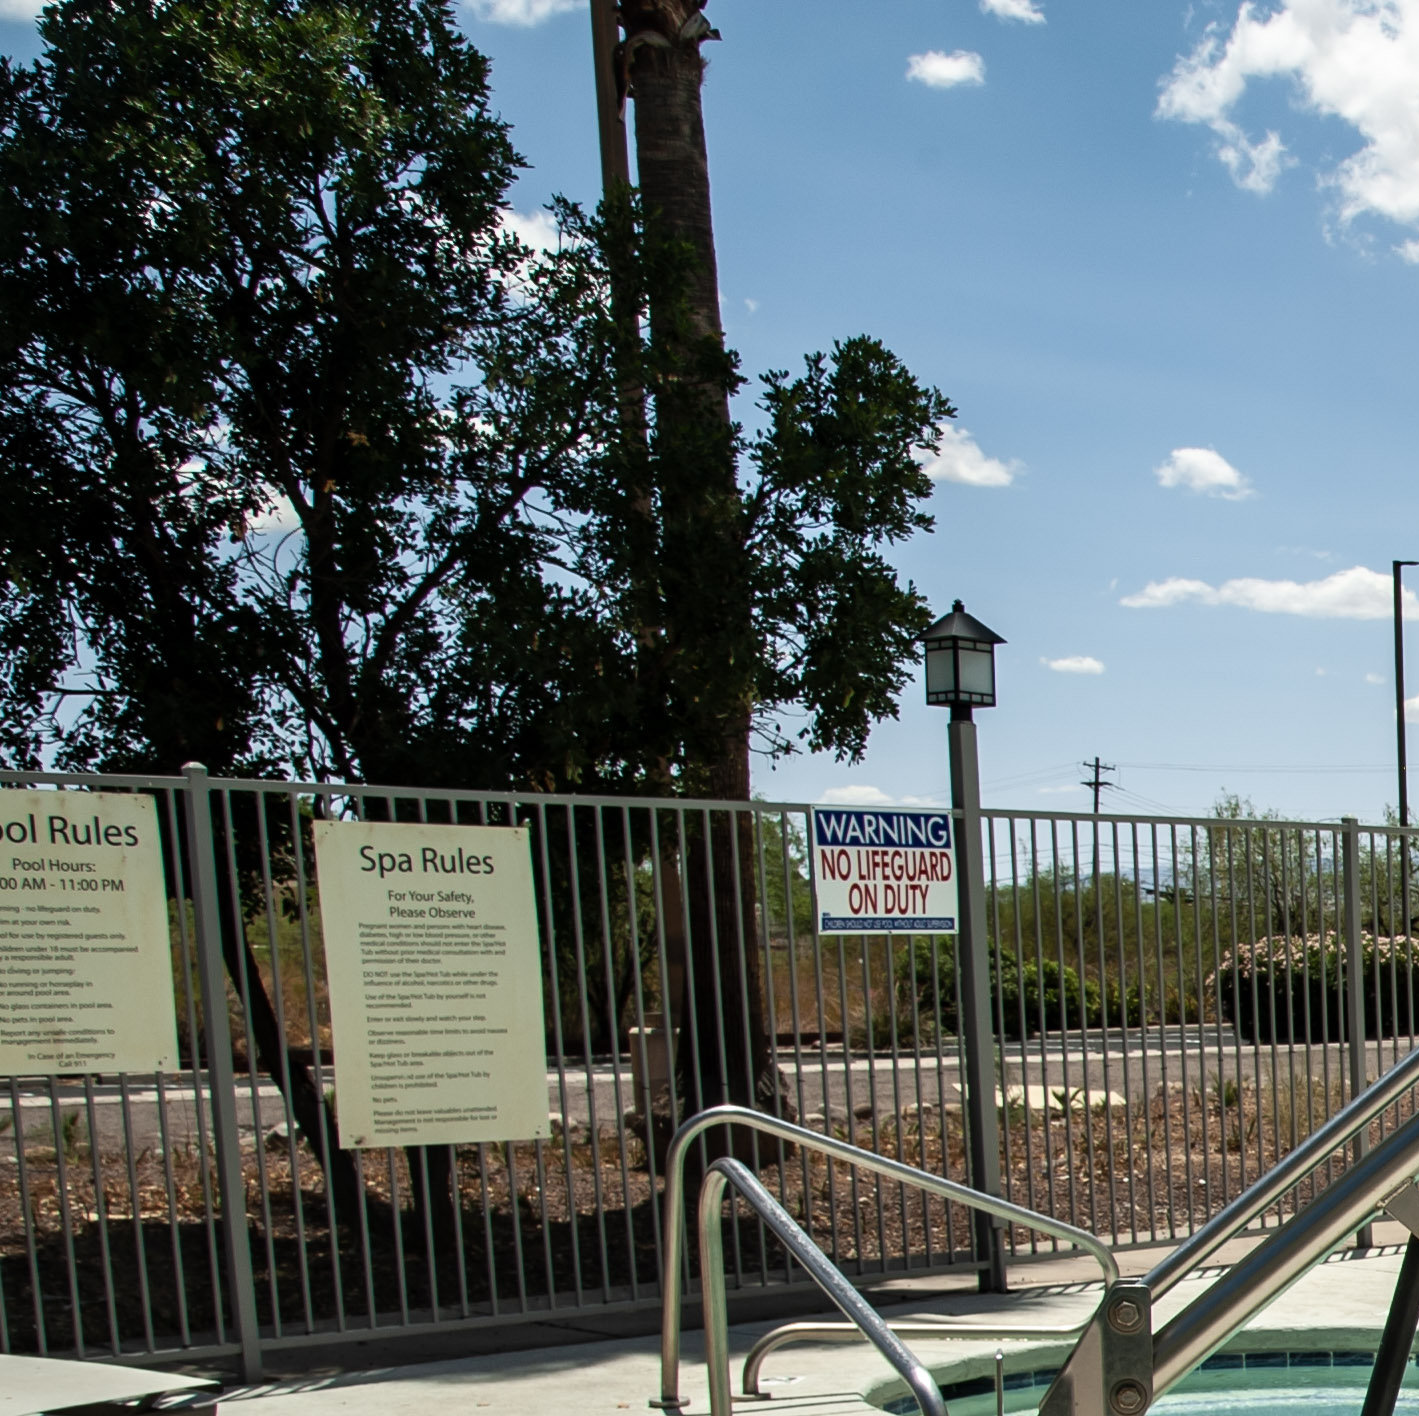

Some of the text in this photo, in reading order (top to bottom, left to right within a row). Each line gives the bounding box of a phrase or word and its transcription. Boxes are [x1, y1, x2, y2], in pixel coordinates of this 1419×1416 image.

[0, 814, 138, 846] ol Rules
[819, 813, 947, 846] WARNING
[13, 858, 96, 872] Pool Hours:
[360, 845, 494, 878] Spa Rules
[821, 849, 951, 882] NO LIFEGUARD
[21, 878, 46, 890] AM
[60, 879, 98, 891] 11:00
[102, 879, 124, 892] PM
[388, 890, 474, 904] For Your Safety,
[849, 883, 929, 915] ON DUTY
[389, 906, 475, 918] Please Observe
